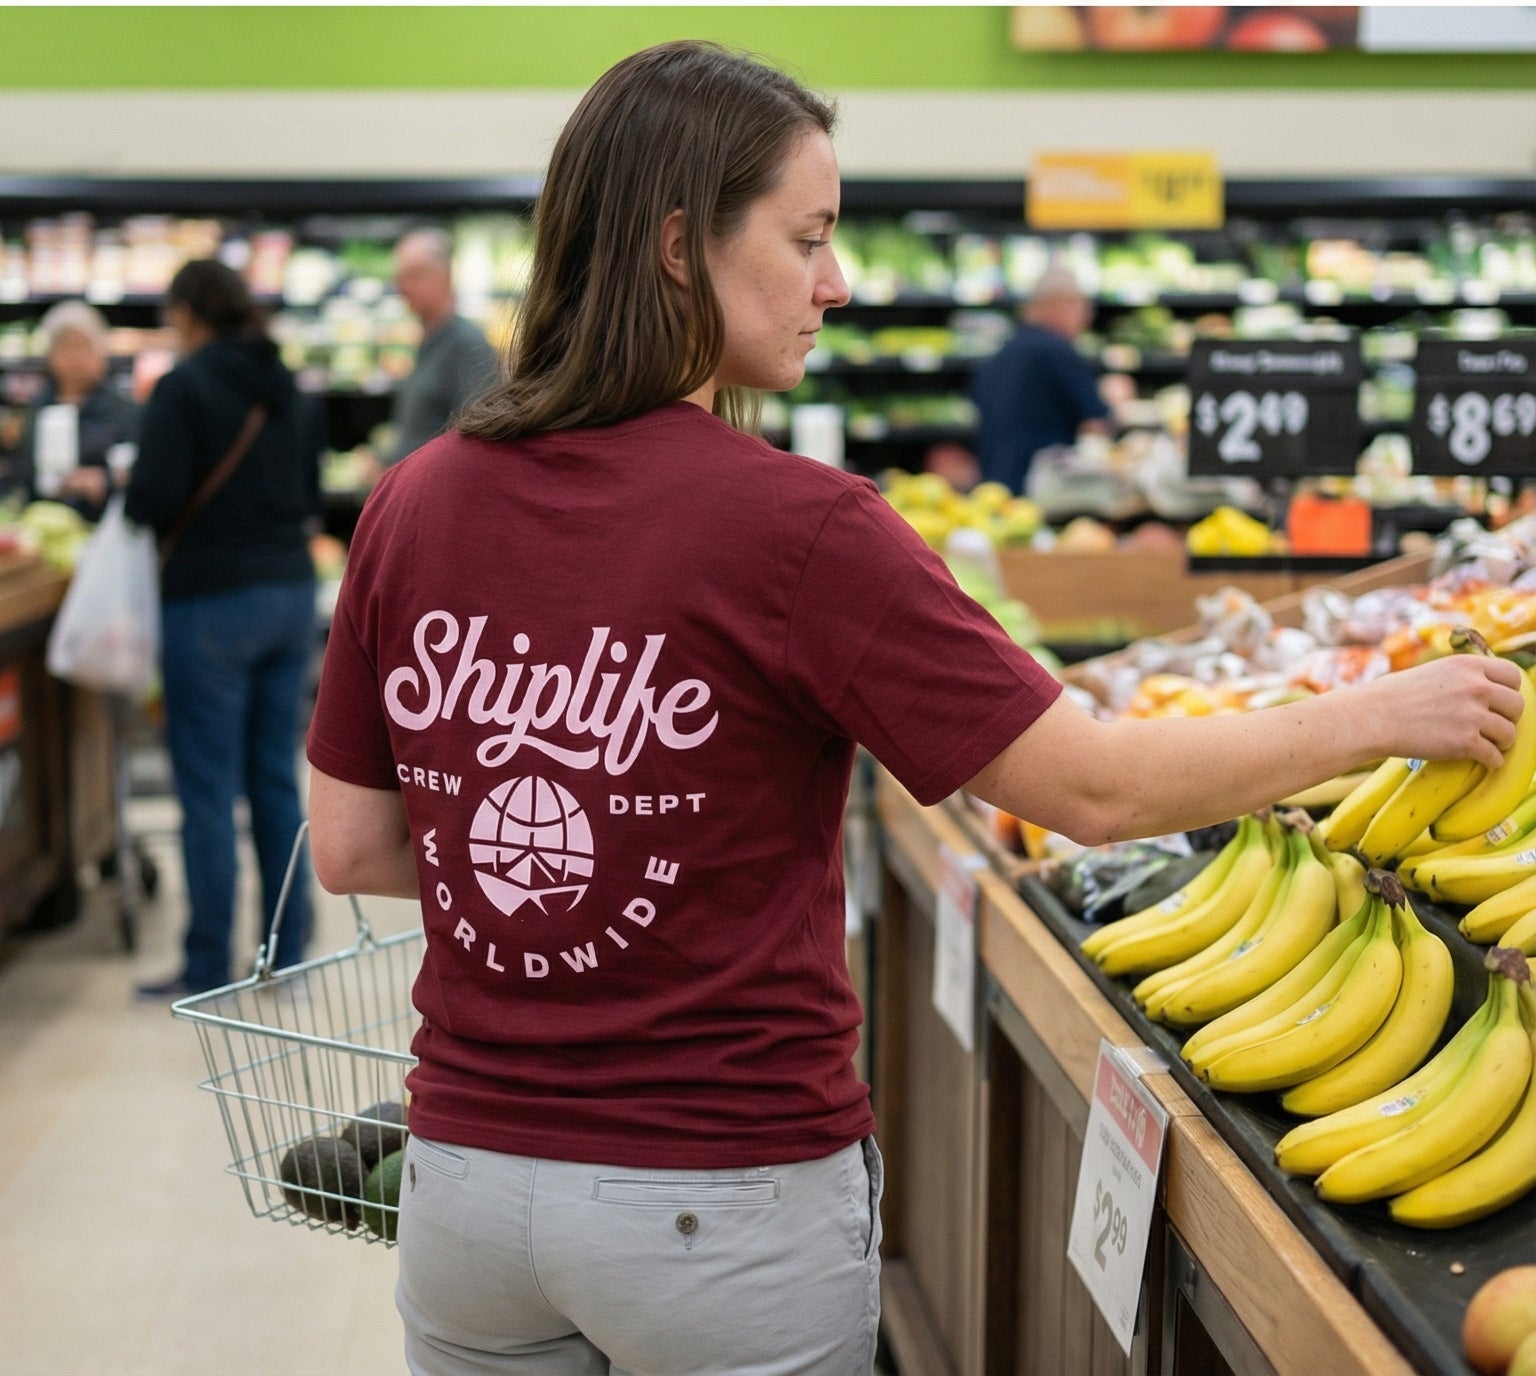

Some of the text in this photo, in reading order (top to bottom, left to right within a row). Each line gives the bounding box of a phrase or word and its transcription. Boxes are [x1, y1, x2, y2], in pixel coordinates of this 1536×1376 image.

[384, 609, 719, 776] Shiplife
[396, 762, 706, 816] CREW DEPT
[422, 827, 680, 979] WORLDWIDE
